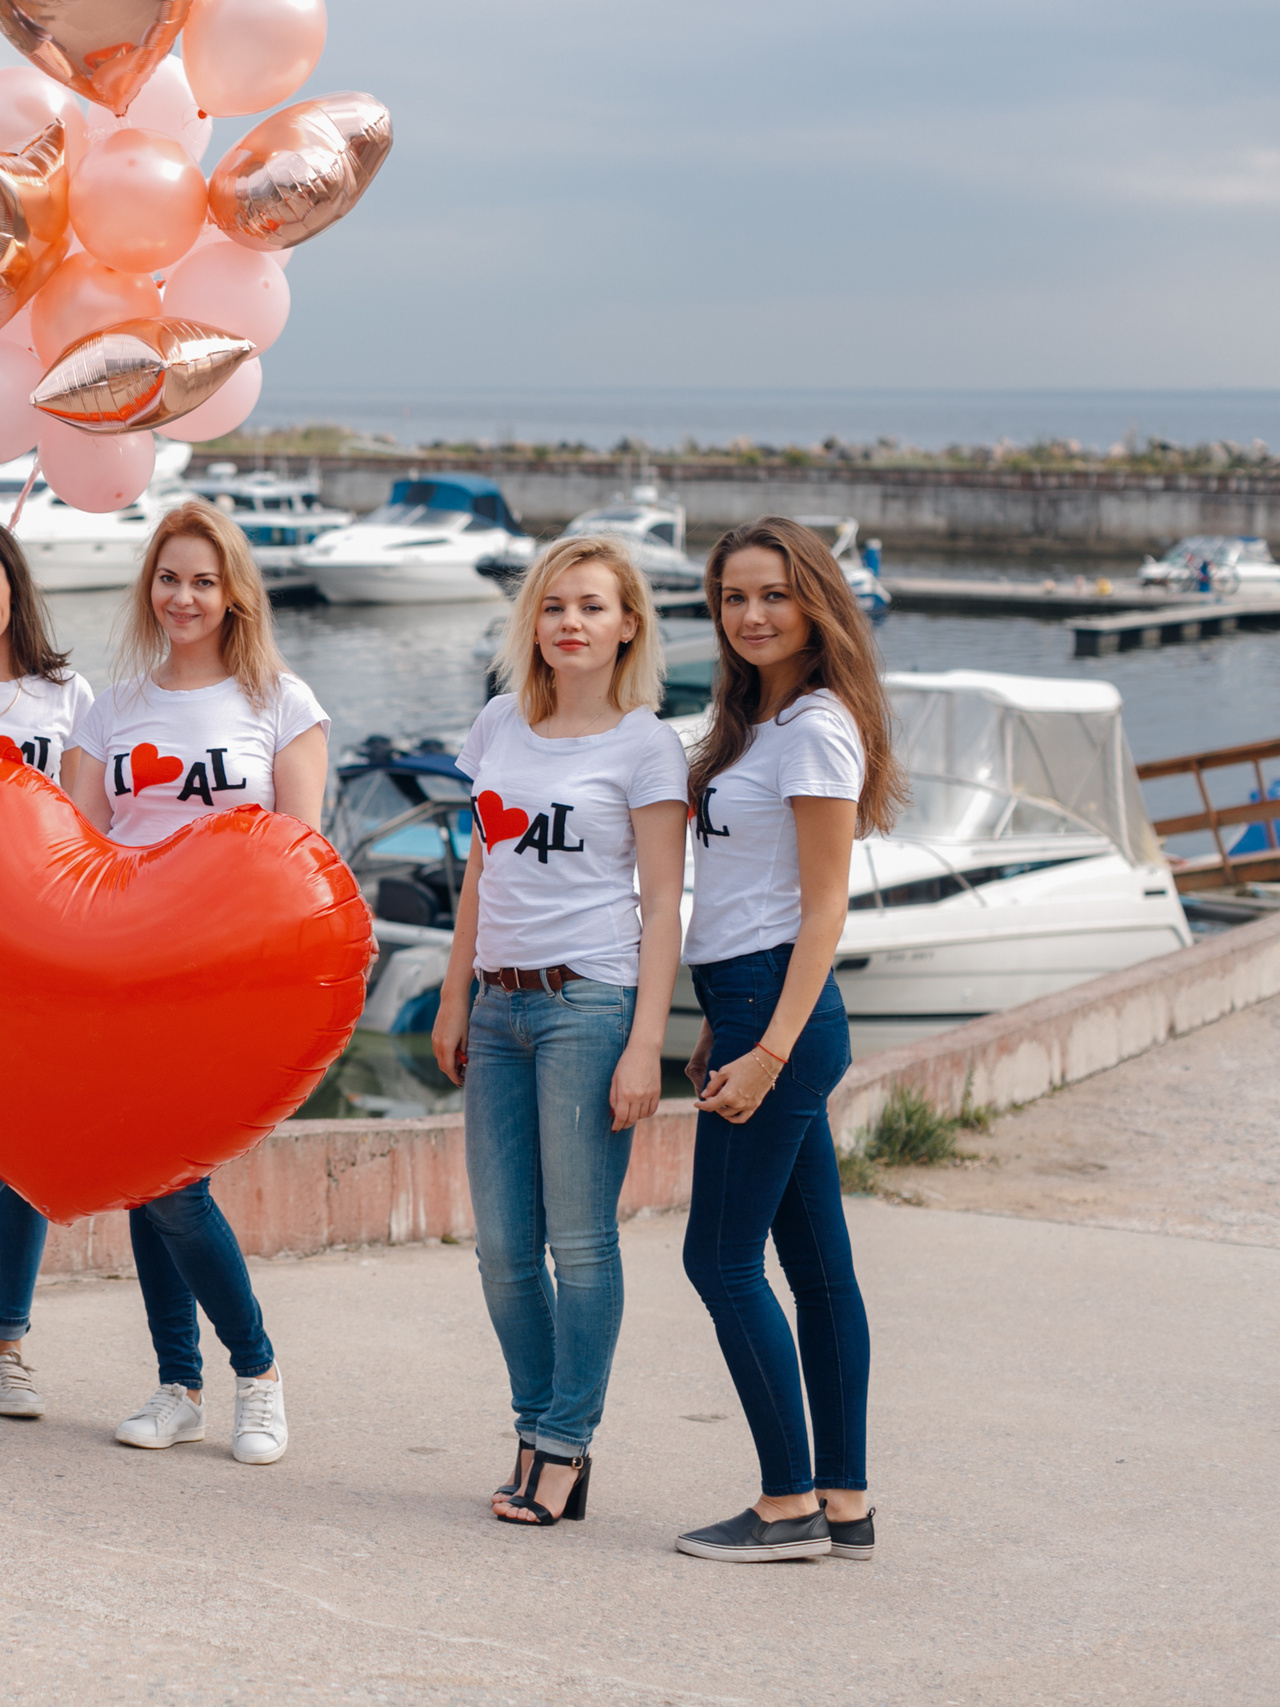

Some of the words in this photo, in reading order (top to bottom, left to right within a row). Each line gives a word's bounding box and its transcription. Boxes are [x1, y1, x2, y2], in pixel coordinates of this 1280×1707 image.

[113, 752, 132, 796] I
[176, 747, 247, 806] AL
[513, 802, 584, 864] AL
